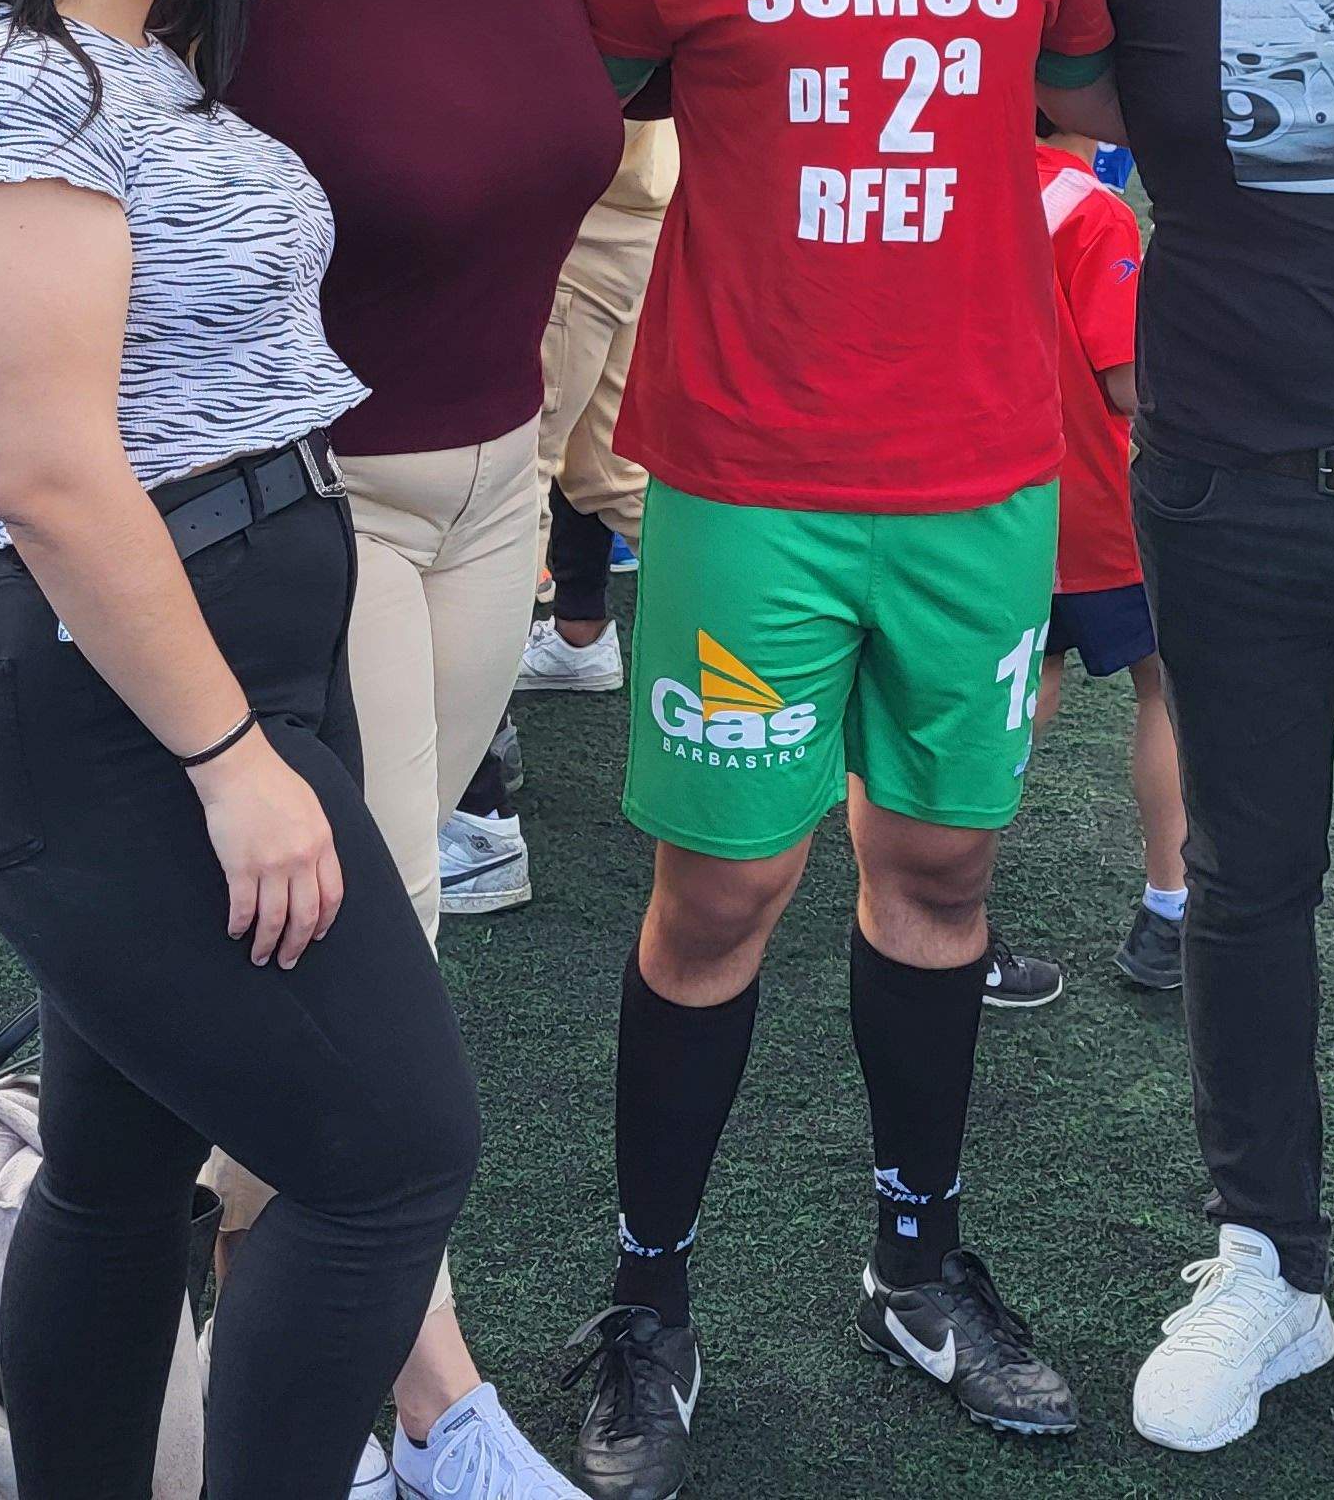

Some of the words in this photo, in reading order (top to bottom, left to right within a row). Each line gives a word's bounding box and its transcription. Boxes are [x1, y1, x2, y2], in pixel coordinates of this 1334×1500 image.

[789, 66, 850, 124] DE
[797, 165, 958, 244] RFEF
[995, 619, 1050, 732] 1
[651, 677, 817, 750] Gas
[662, 735, 806, 770] BARBASTRO
